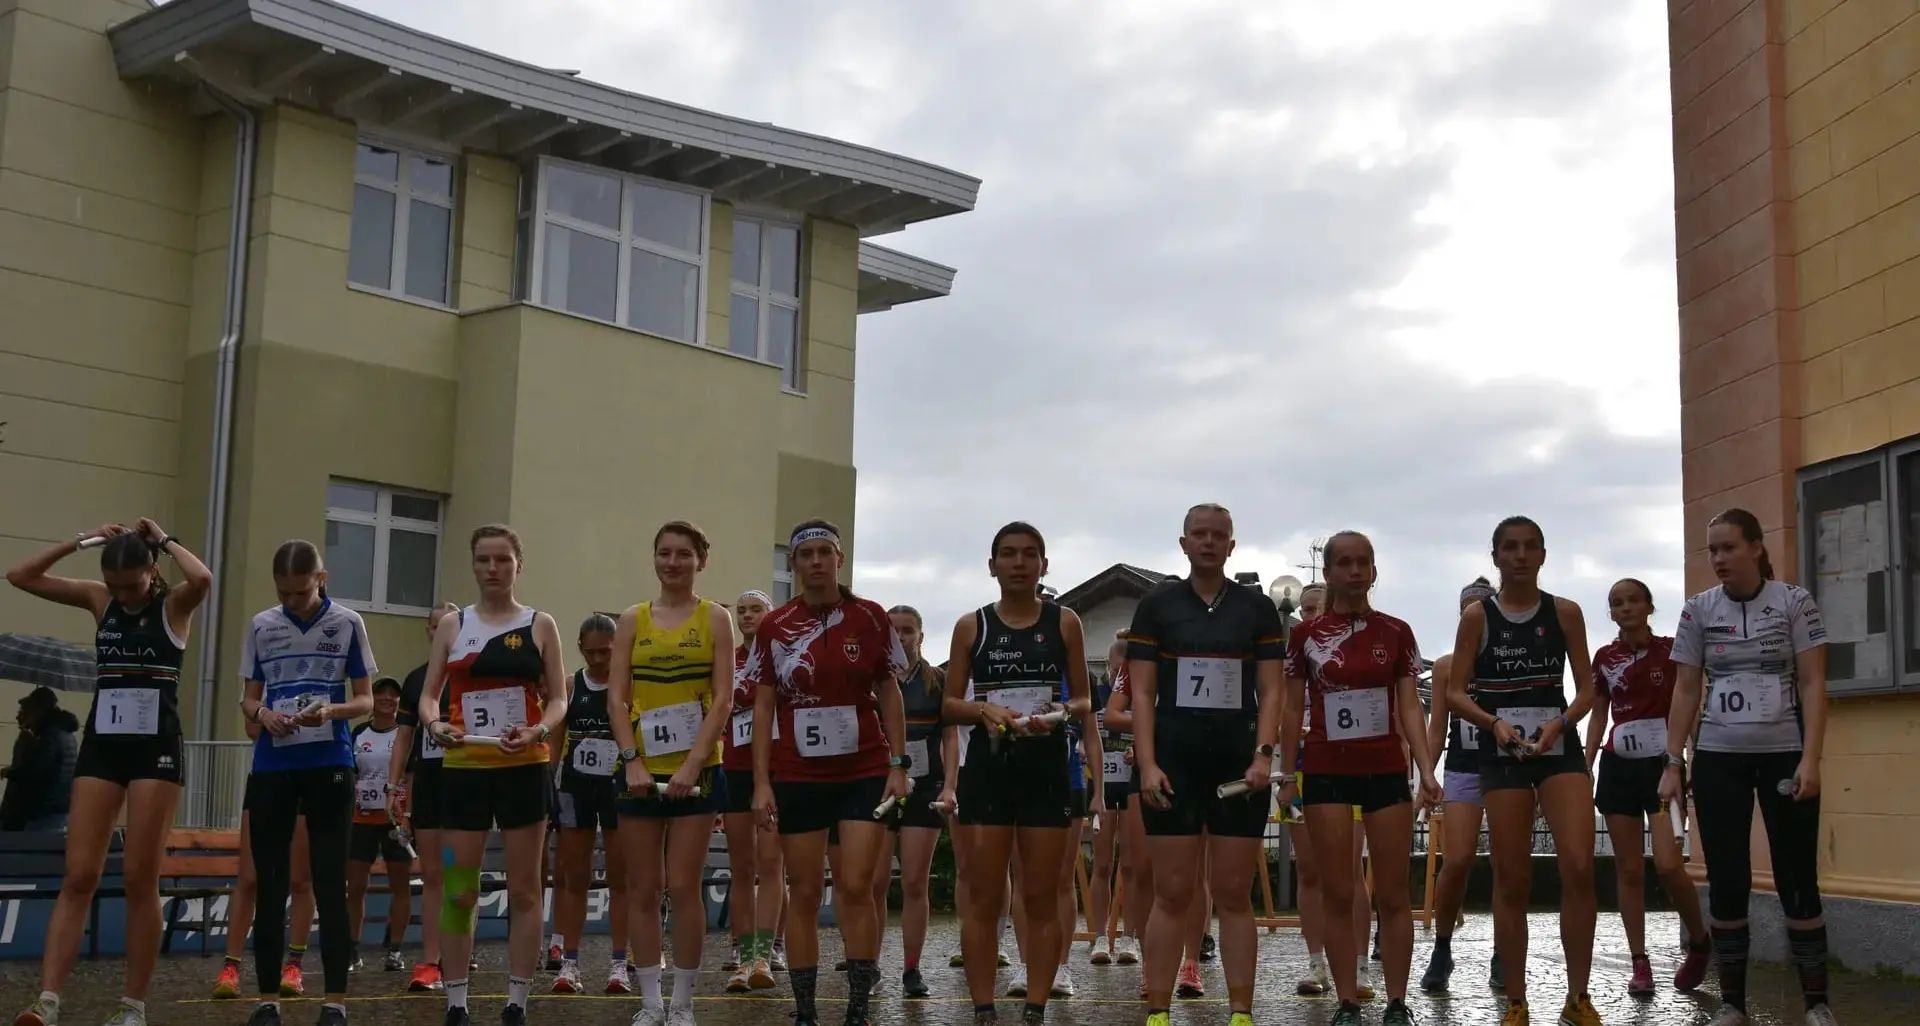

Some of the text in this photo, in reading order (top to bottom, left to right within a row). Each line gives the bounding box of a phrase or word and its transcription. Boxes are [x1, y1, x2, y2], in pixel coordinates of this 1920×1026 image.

[99, 645, 157, 658] TALIA
[987, 649, 1023, 661] TRENTINO
[988, 662, 1058, 675] ITALIA
[1496, 656, 1560, 672] ITALIA
[1190, 675, 1205, 697] 7
[1719, 691, 1745, 713] 10
[110, 705, 117, 724] 1
[473, 707, 489, 728] 3
[576, 718, 609, 728] ITAL
[1337, 707, 1354, 729] 8
[654, 725, 670, 743] 4
[806, 725, 821, 746] 5
[1622, 734, 1637, 751] 11
[580, 750, 597, 767] 18
[361, 789, 378, 801] 29
